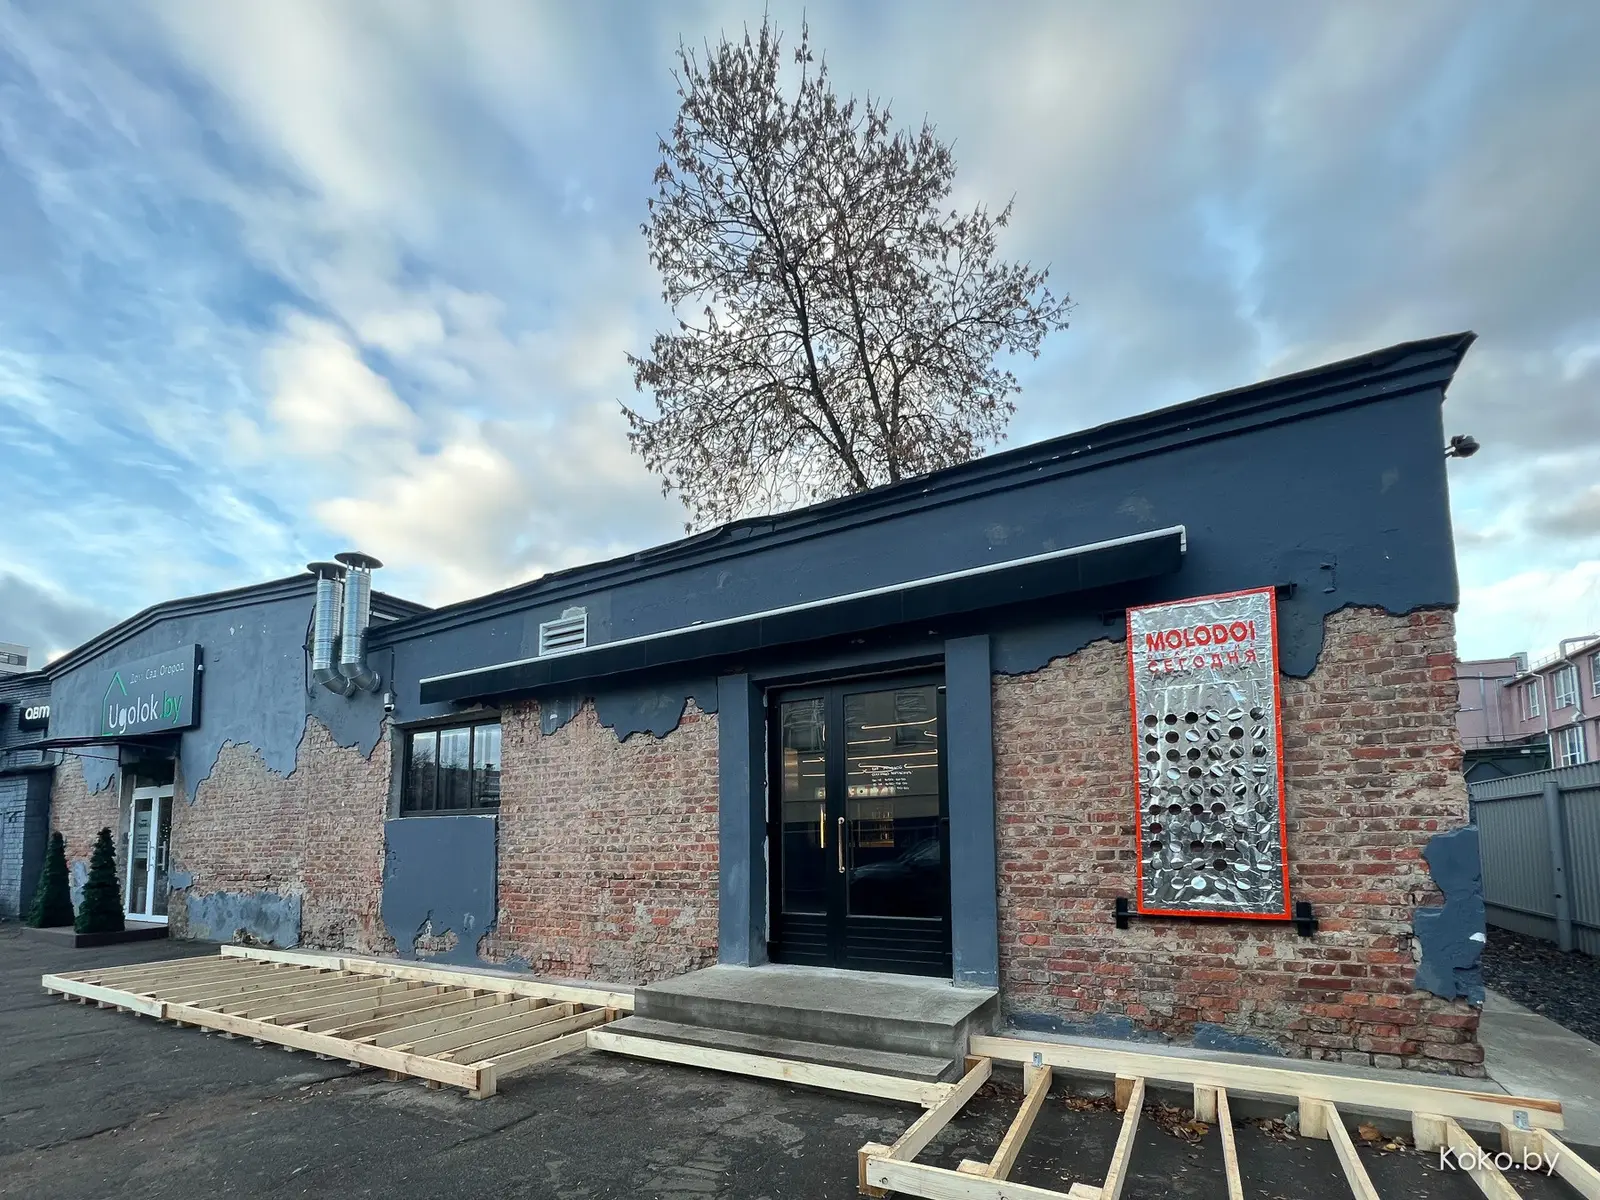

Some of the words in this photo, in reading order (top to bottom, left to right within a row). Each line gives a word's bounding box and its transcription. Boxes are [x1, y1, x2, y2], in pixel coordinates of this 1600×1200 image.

[1145, 620, 1256, 652] MOLODOI
[145, 668, 157, 680] Сад
[159, 662, 185, 676] Огород
[1147, 649, 1257, 674] СЕГОДНЯ
[108, 690, 183, 735] Ugolok.by
